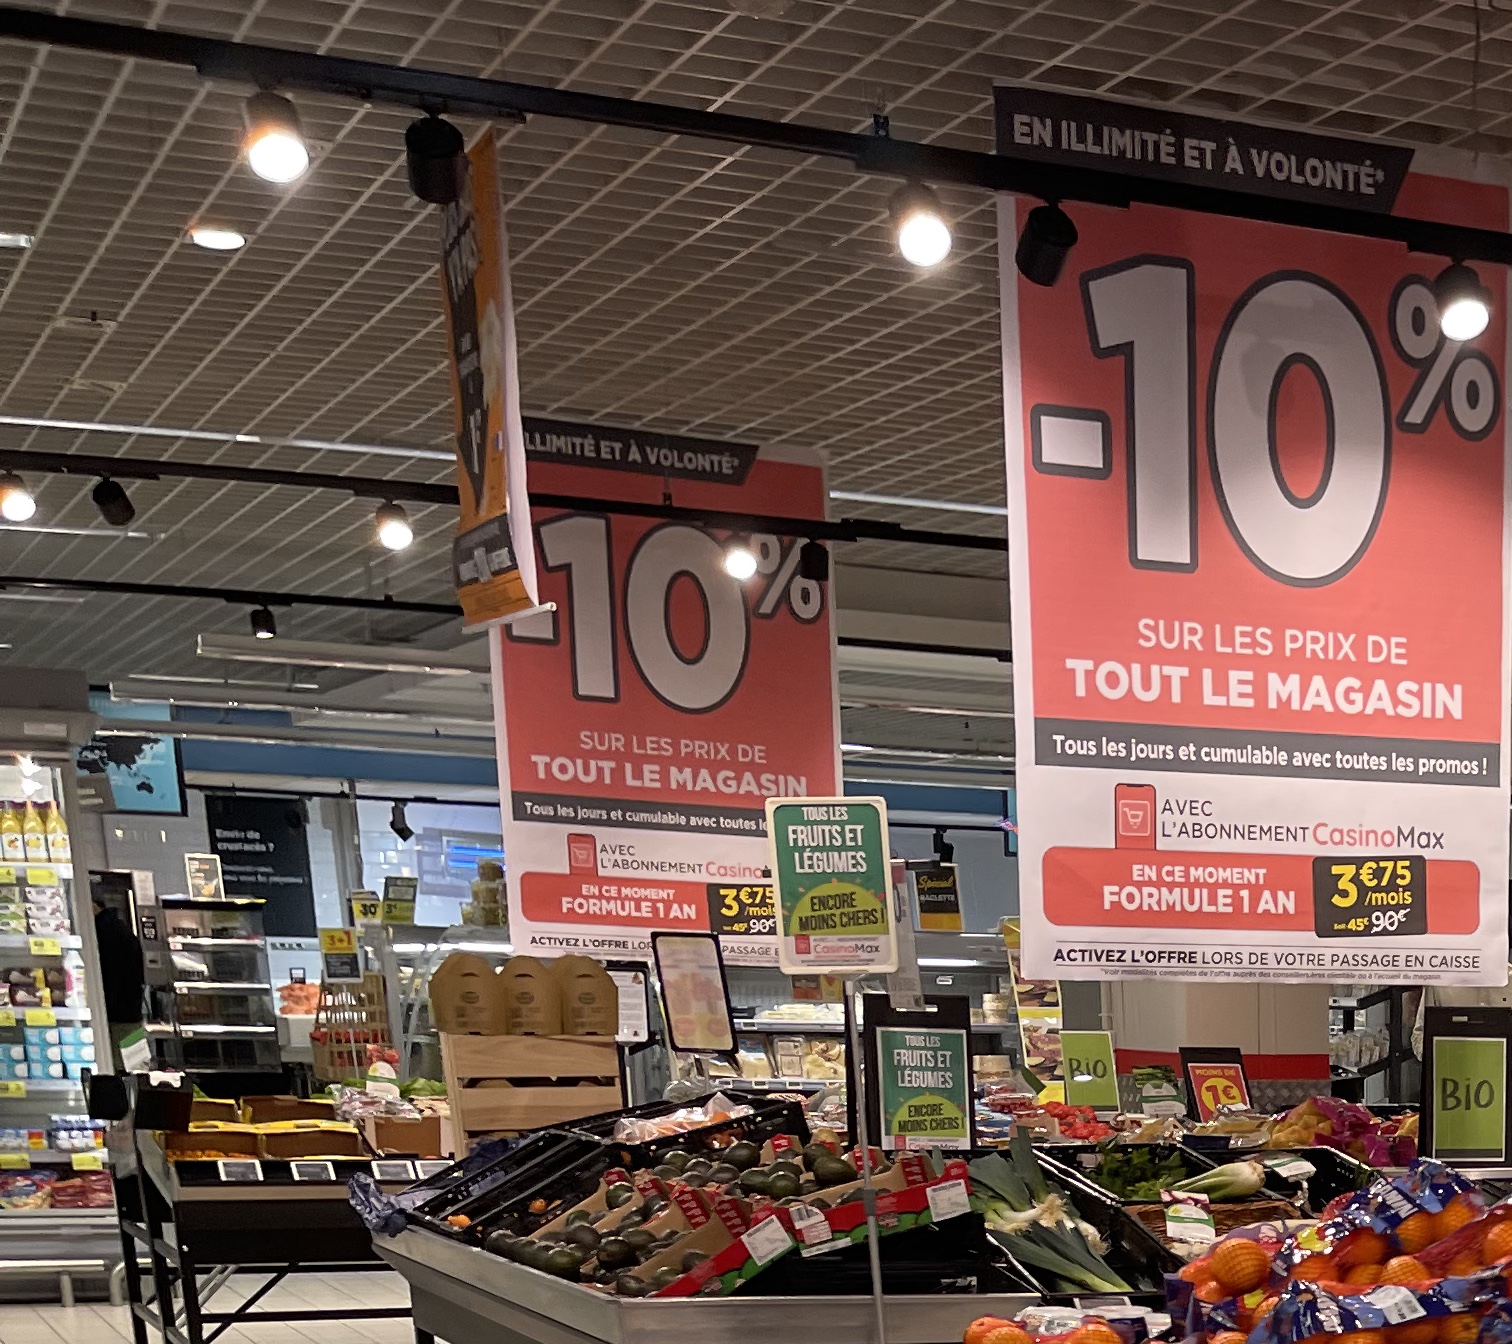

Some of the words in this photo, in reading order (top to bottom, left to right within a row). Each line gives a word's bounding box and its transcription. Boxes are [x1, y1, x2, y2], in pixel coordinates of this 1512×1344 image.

[1012, 113, 1052, 147] EN
[1061, 119, 1175, 165] ILLIMITÉ
[1184, 137, 1217, 170] ET
[1224, 138, 1246, 174] À
[525, 432, 595, 458] LLIMITÉ
[600, 440, 623, 461] ET
[627, 438, 641, 464] À
[1138, 618, 1203, 651] SUR
[1215, 625, 1273, 655] LES
[1285, 629, 1357, 661] PRIX
[1367, 634, 1408, 665] DE
[1065, 658, 1190, 701] TOUT
[1202, 668, 1255, 706] LE
[1267, 673, 1463, 721] MAGASIN
[580, 731, 624, 752] SUR
[632, 736, 673, 756] LES
[681, 739, 730, 760] PRIX
[738, 744, 766, 764] DE
[1053, 735, 1097, 756] Tous
[1102, 737, 1127, 759] les
[1130, 739, 1174, 762] jours
[1179, 742, 1197, 761] et
[1200, 743, 1288, 767] cumulable
[1293, 751, 1331, 769] avec
[1335, 752, 1387, 772] toutes
[1391, 752, 1415, 773] les
[531, 755, 616, 784] TOUT
[625, 763, 660, 788] LE
[669, 766, 807, 797] MAGASIN
[801, 806, 828, 820] TOUS
[829, 806, 848, 820] LES
[1161, 799, 1213, 817] AVEC
[787, 825, 842, 847] FRUITS
[845, 825, 864, 846] ET
[1162, 820, 1310, 844] L'ABONNEMENT
[1312, 822, 1445, 851] CasinoMax
[793, 848, 867, 873] LÉGUMES
[1132, 864, 1158, 882] EN
[1161, 865, 1187, 882] CE
[1189, 866, 1266, 885] MOMENT
[810, 891, 857, 912] ENCORE
[1103, 884, 1234, 915] FORMULE
[1240, 889, 1251, 912] 1
[1257, 890, 1296, 915] AN
[1364, 888, 1413, 906] /mois
[798, 913, 837, 932] MOINS
[839, 909, 879, 928] CHERS
[1053, 948, 1126, 963] ACTIVEZ
[1131, 950, 1198, 964] L'OFFRE
[1202, 951, 1243, 965] LORS
[1249, 952, 1268, 966] DE
[1274, 953, 1325, 966] VOTRE
[1331, 954, 1400, 967] PASSAGE
[1405, 955, 1424, 968] EN
[1429, 955, 1480, 969] CAISSE
[1204, 1085, 1237, 1106] 1€
